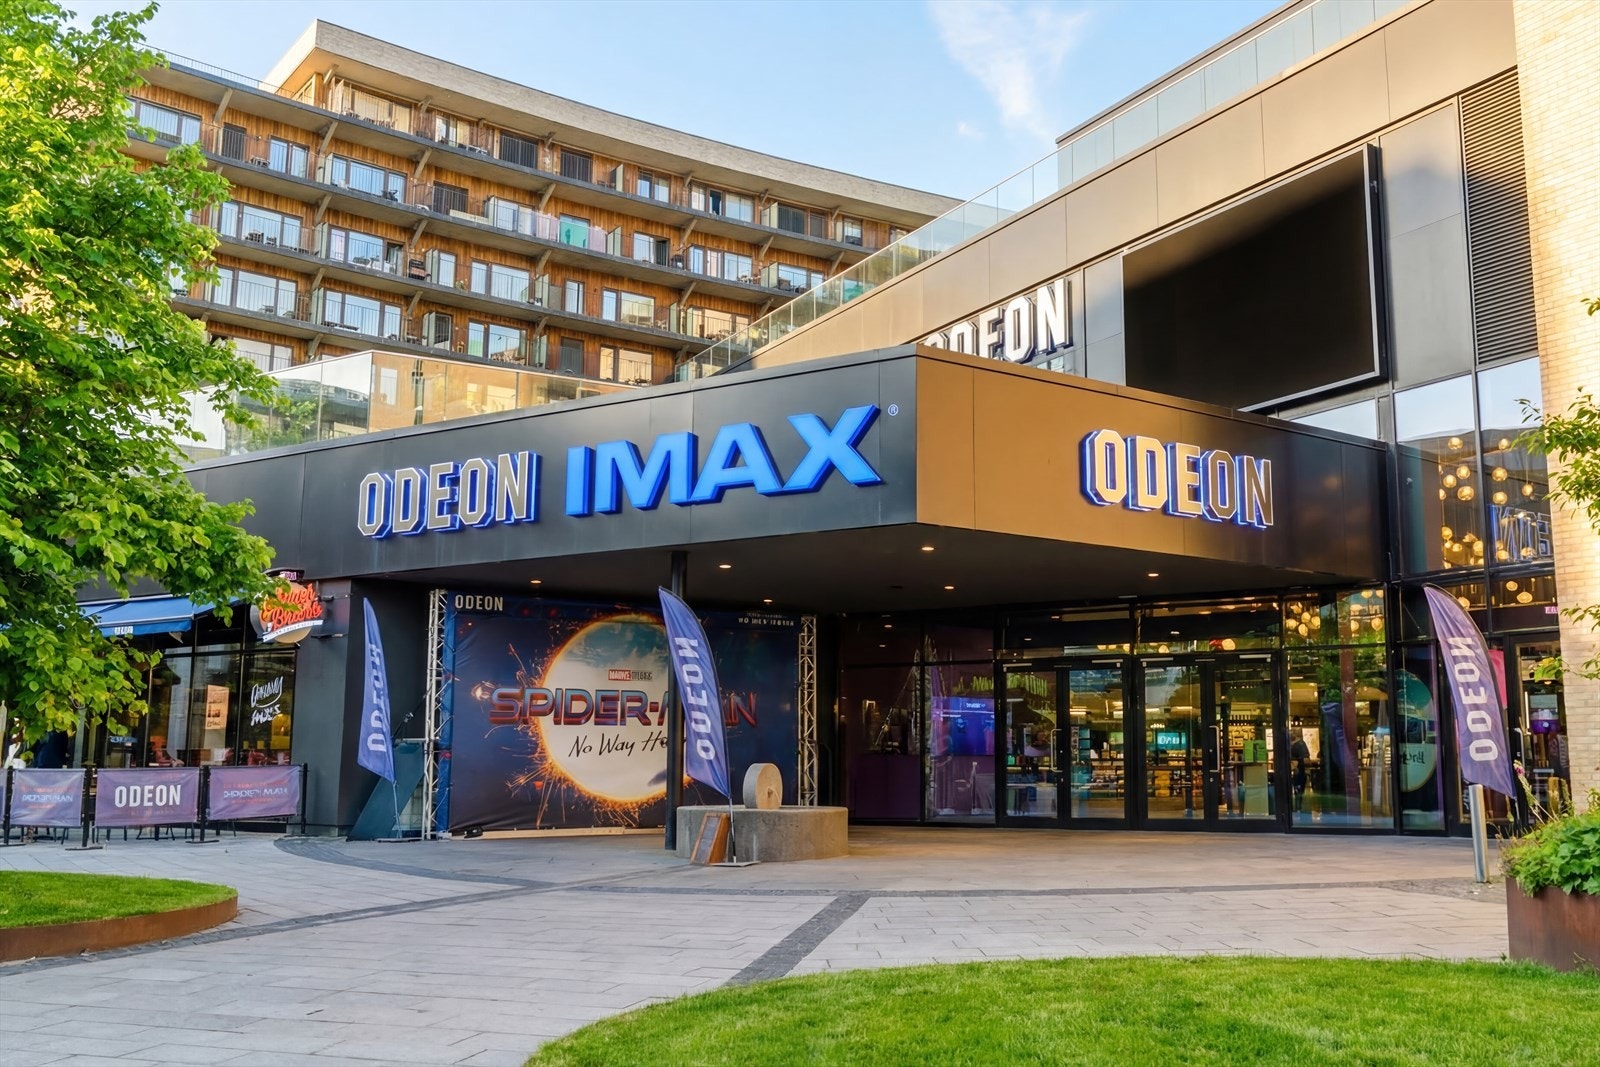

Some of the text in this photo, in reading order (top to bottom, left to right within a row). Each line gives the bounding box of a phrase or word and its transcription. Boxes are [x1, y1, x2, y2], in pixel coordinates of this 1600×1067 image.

[924, 278, 1073, 363] DEON
[357, 451, 540, 538] ODEON
[565, 404, 886, 517] IMAX
[1081, 429, 1274, 529] ODEON
[455, 594, 503, 611] ODEON
[488, 687, 758, 728] SPIDER-N
[675, 637, 716, 761] ODEON
[1448, 637, 1498, 761] ODEON
[568, 735, 593, 757] No
[599, 733, 635, 756] Way
[114, 785, 181, 807] ODEON
